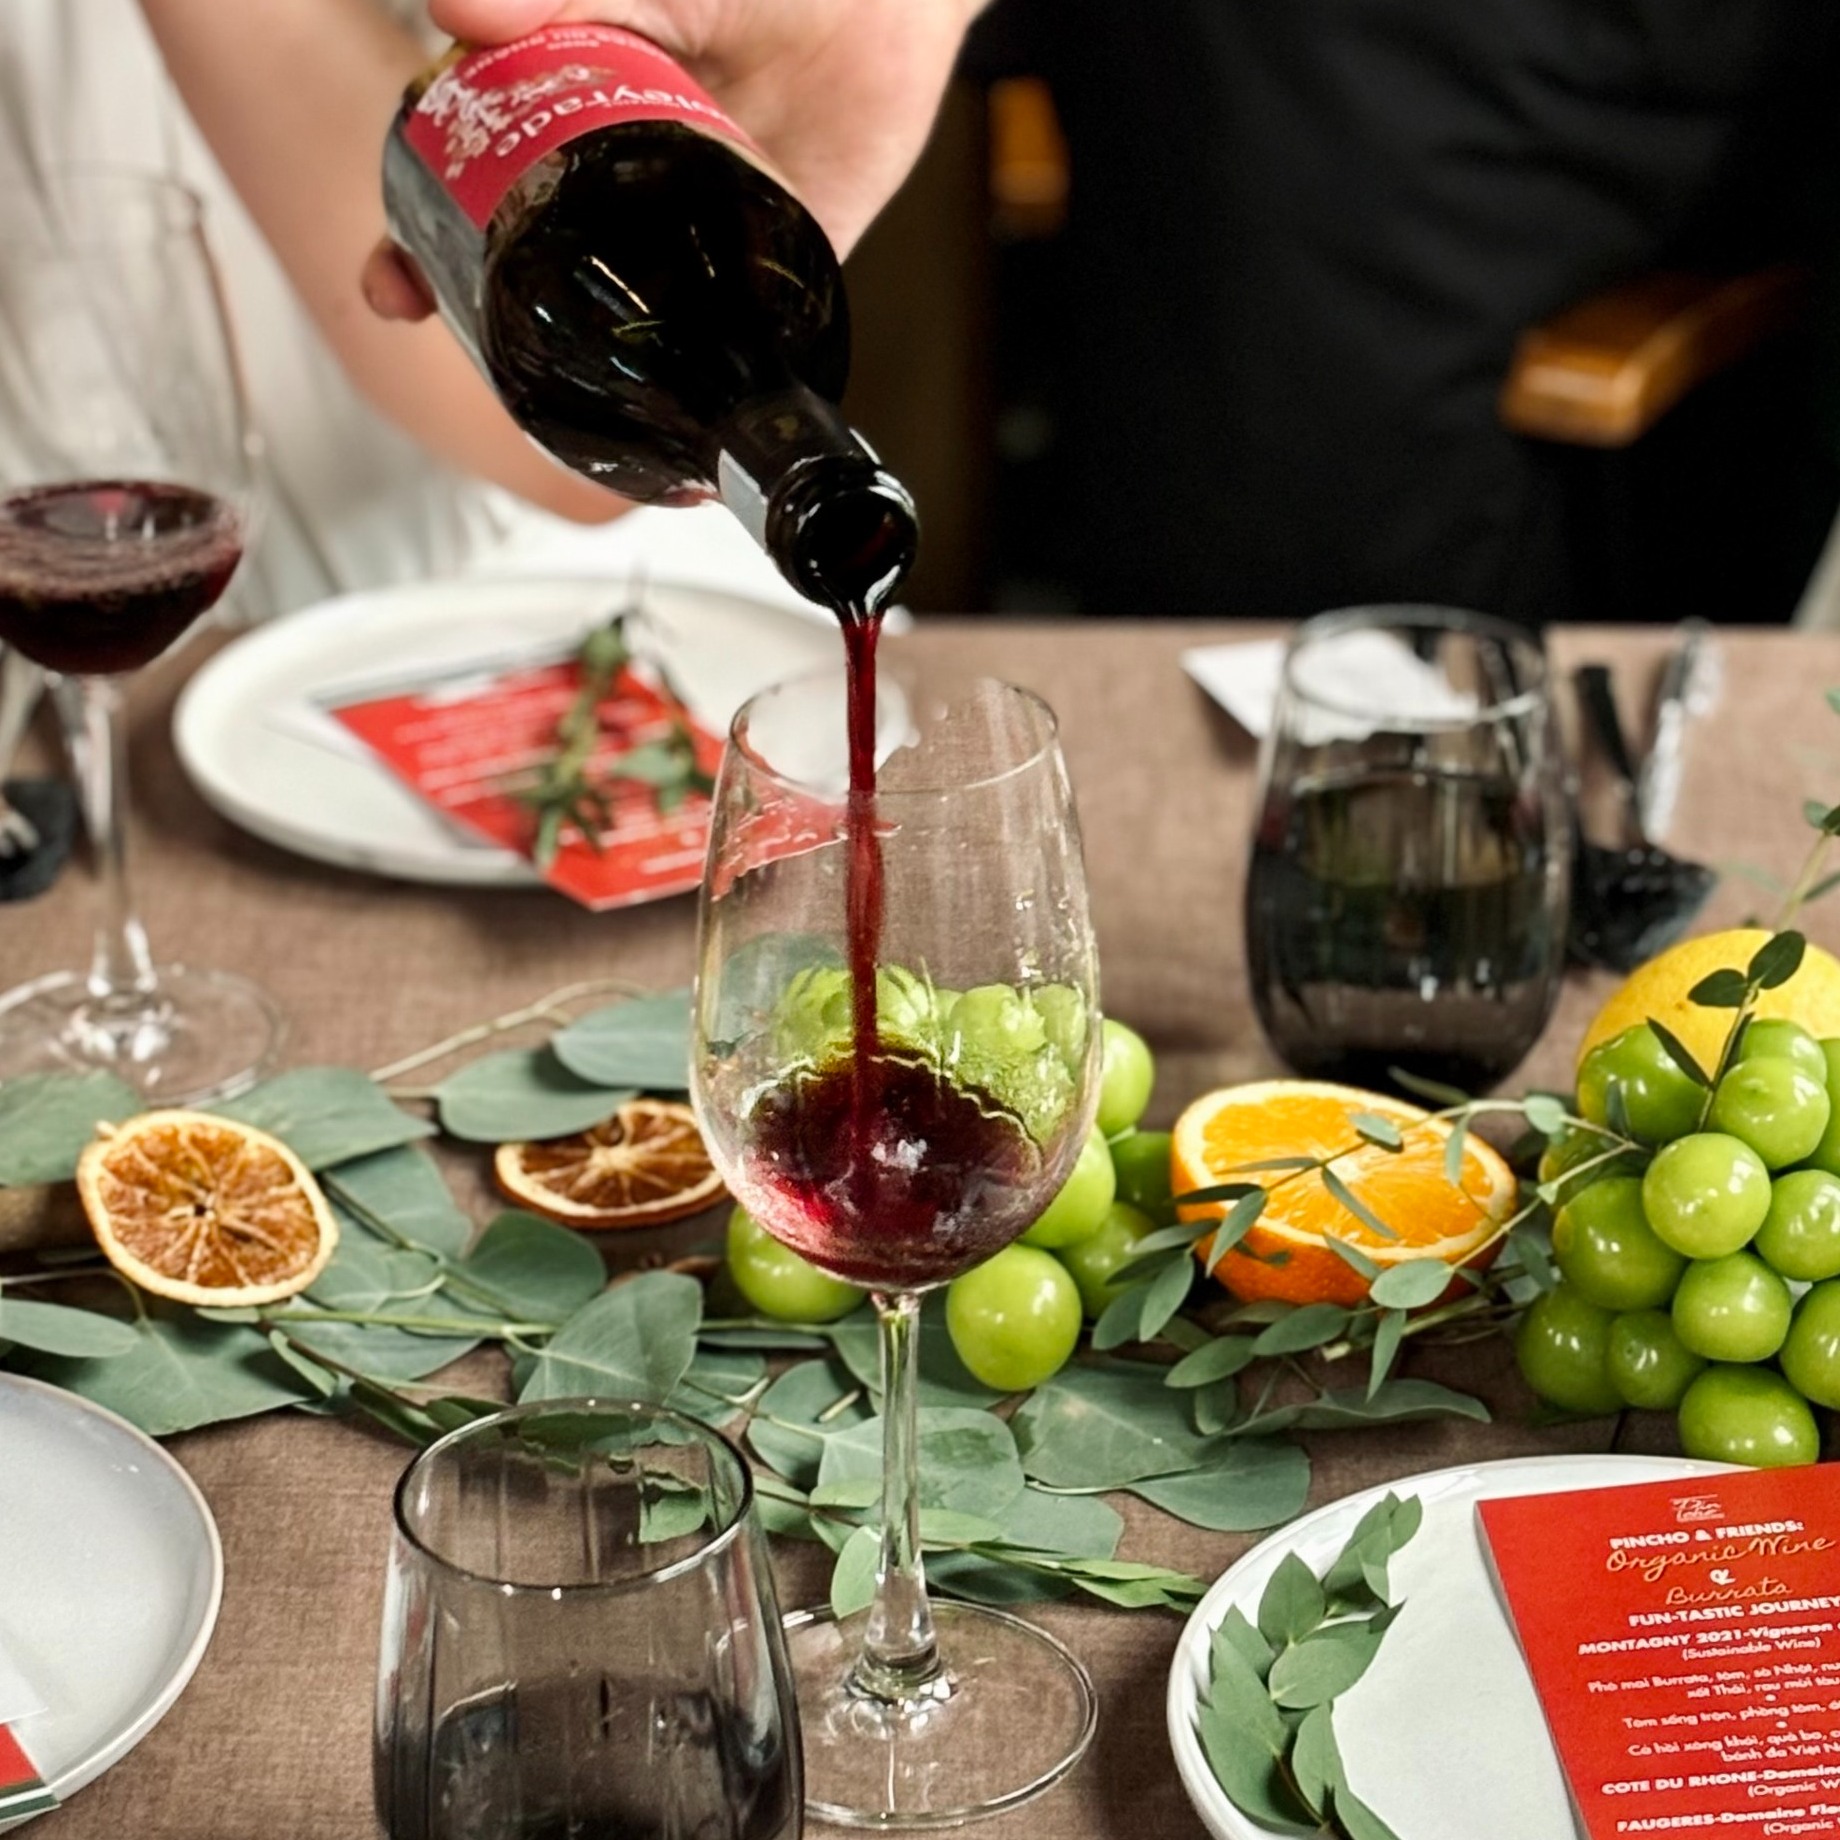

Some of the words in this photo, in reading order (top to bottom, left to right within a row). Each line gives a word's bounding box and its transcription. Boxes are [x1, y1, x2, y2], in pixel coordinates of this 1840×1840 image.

[1610, 1531, 1690, 1550] PINCHO
[1695, 1529, 1712, 1540] &
[1716, 1520, 1805, 1539] FRIENDS:
[1606, 1547, 1746, 1582] Organic
[1748, 1535, 1836, 1556] Wine
[1710, 1569, 1736, 1586] &
[1665, 1577, 1792, 1605] Burrata
[1629, 1606, 1744, 1627] FUN-TASTIC
[1749, 1596, 1840, 1615] JOURNEY
[1578, 1635, 1690, 1655] MONTAGNY
[1682, 1642, 1771, 1660] (Sustainable
[1776, 1637, 1821, 1650] Wine)
[1601, 1780, 1651, 1794] COTE
[1655, 1777, 1684, 1790] DU
[1748, 1782, 1817, 1798] (Organic
[1764, 1820, 1834, 1835] (Organic
